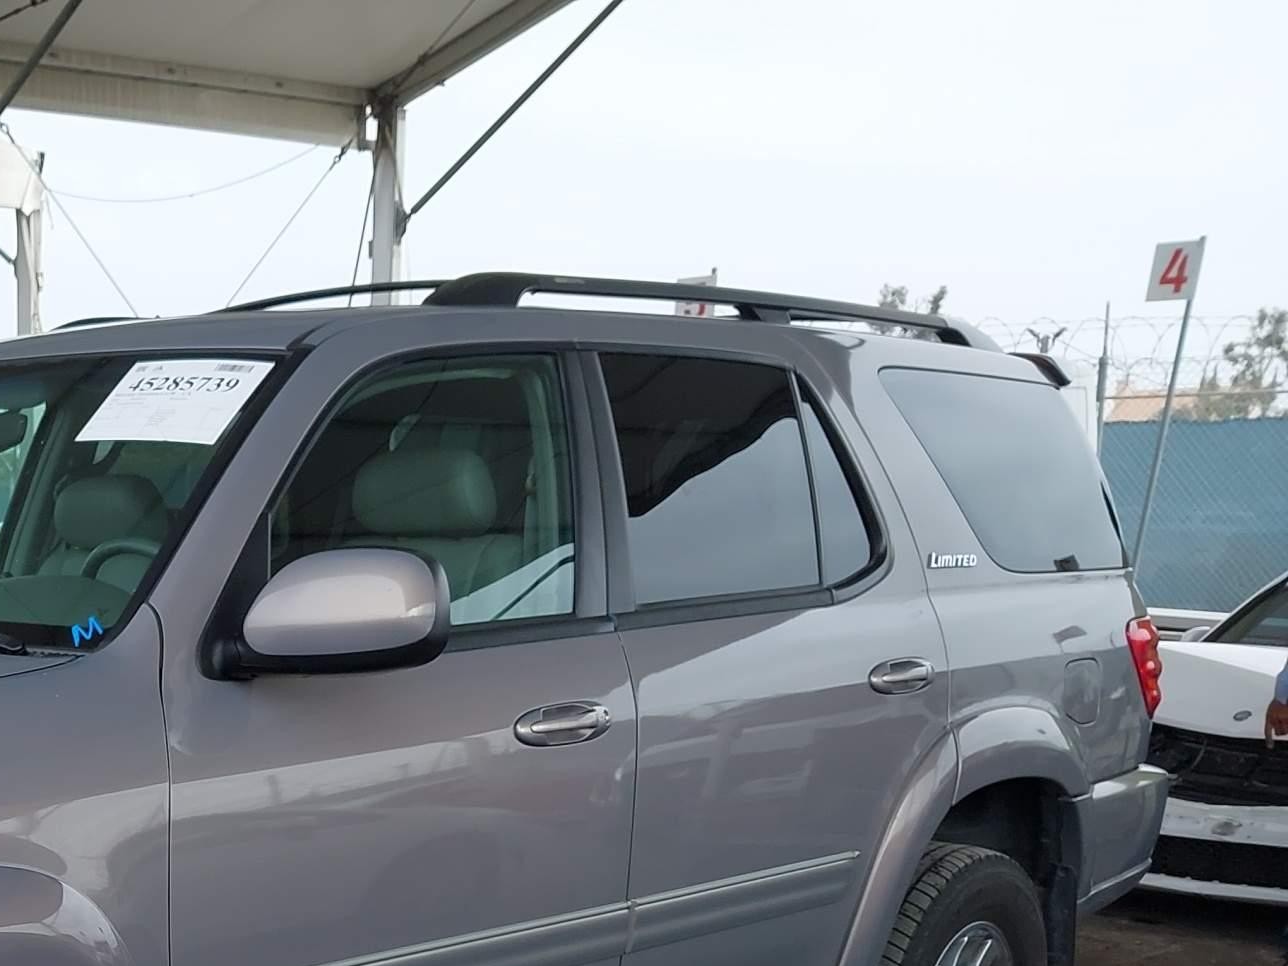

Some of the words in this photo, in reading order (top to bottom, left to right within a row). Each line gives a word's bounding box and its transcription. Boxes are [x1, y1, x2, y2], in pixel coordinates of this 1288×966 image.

[1158, 247, 1189, 294] 4
[128, 375, 240, 393] 45285739
[71, 616, 104, 648] M
